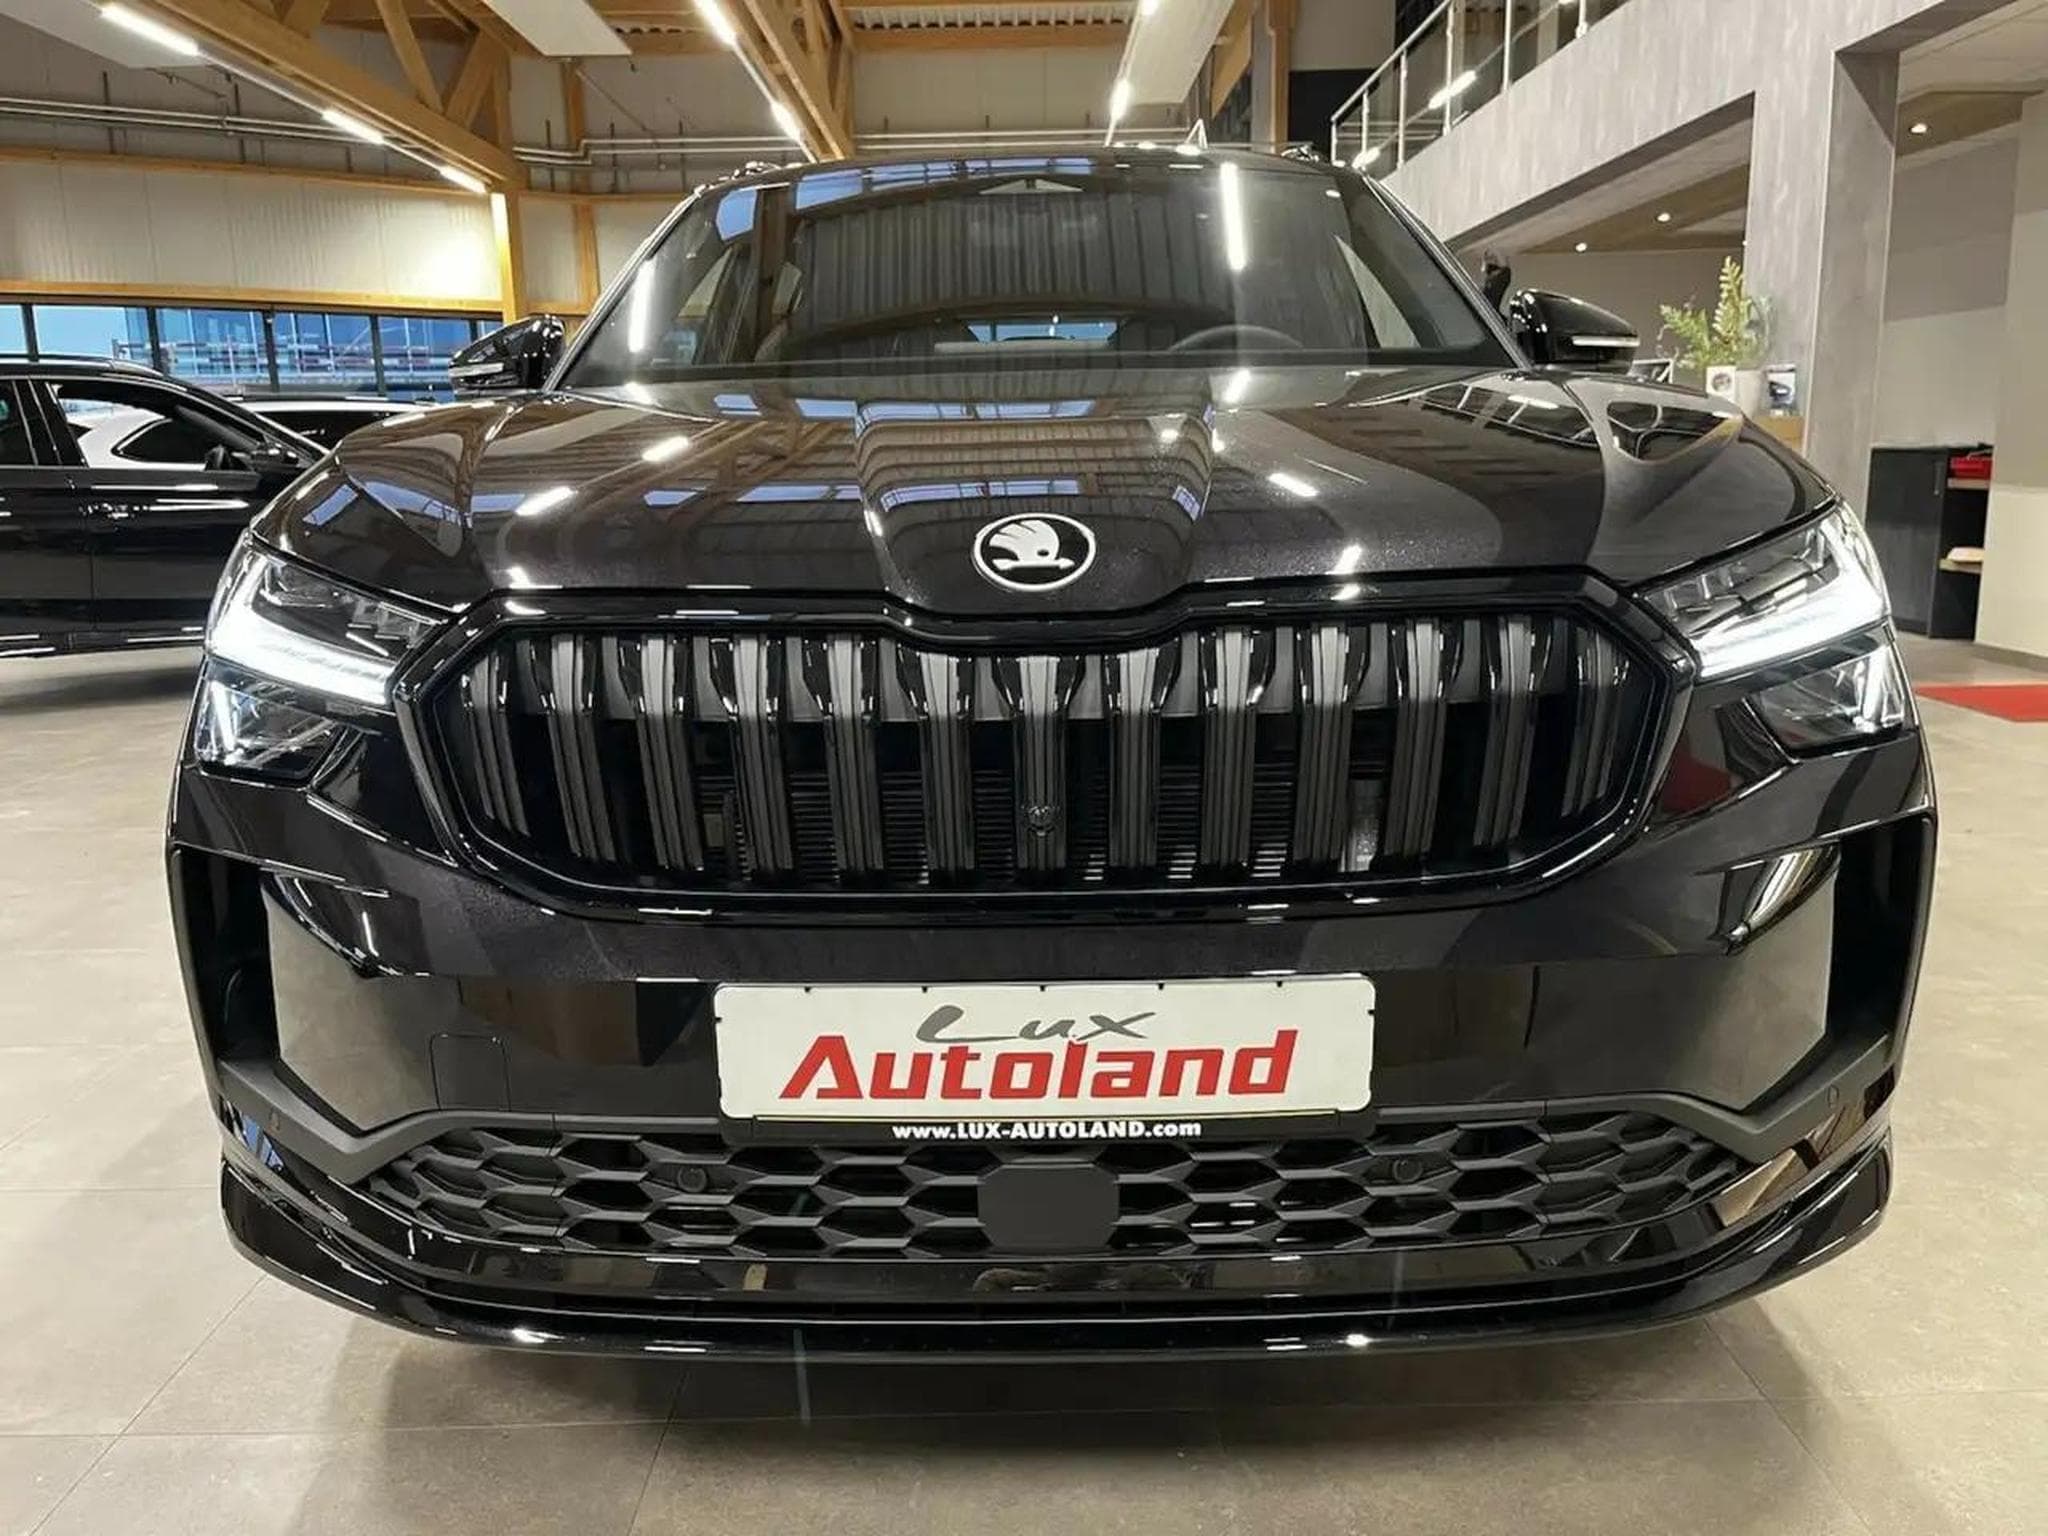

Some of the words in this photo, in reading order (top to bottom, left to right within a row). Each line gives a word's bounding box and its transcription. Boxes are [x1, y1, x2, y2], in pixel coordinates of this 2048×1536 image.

[916, 1005, 1155, 1042] Lux
[779, 1029, 1298, 1099] Autoland
[892, 1120, 1201, 1140] www.LUX-AUTOLAND.com
